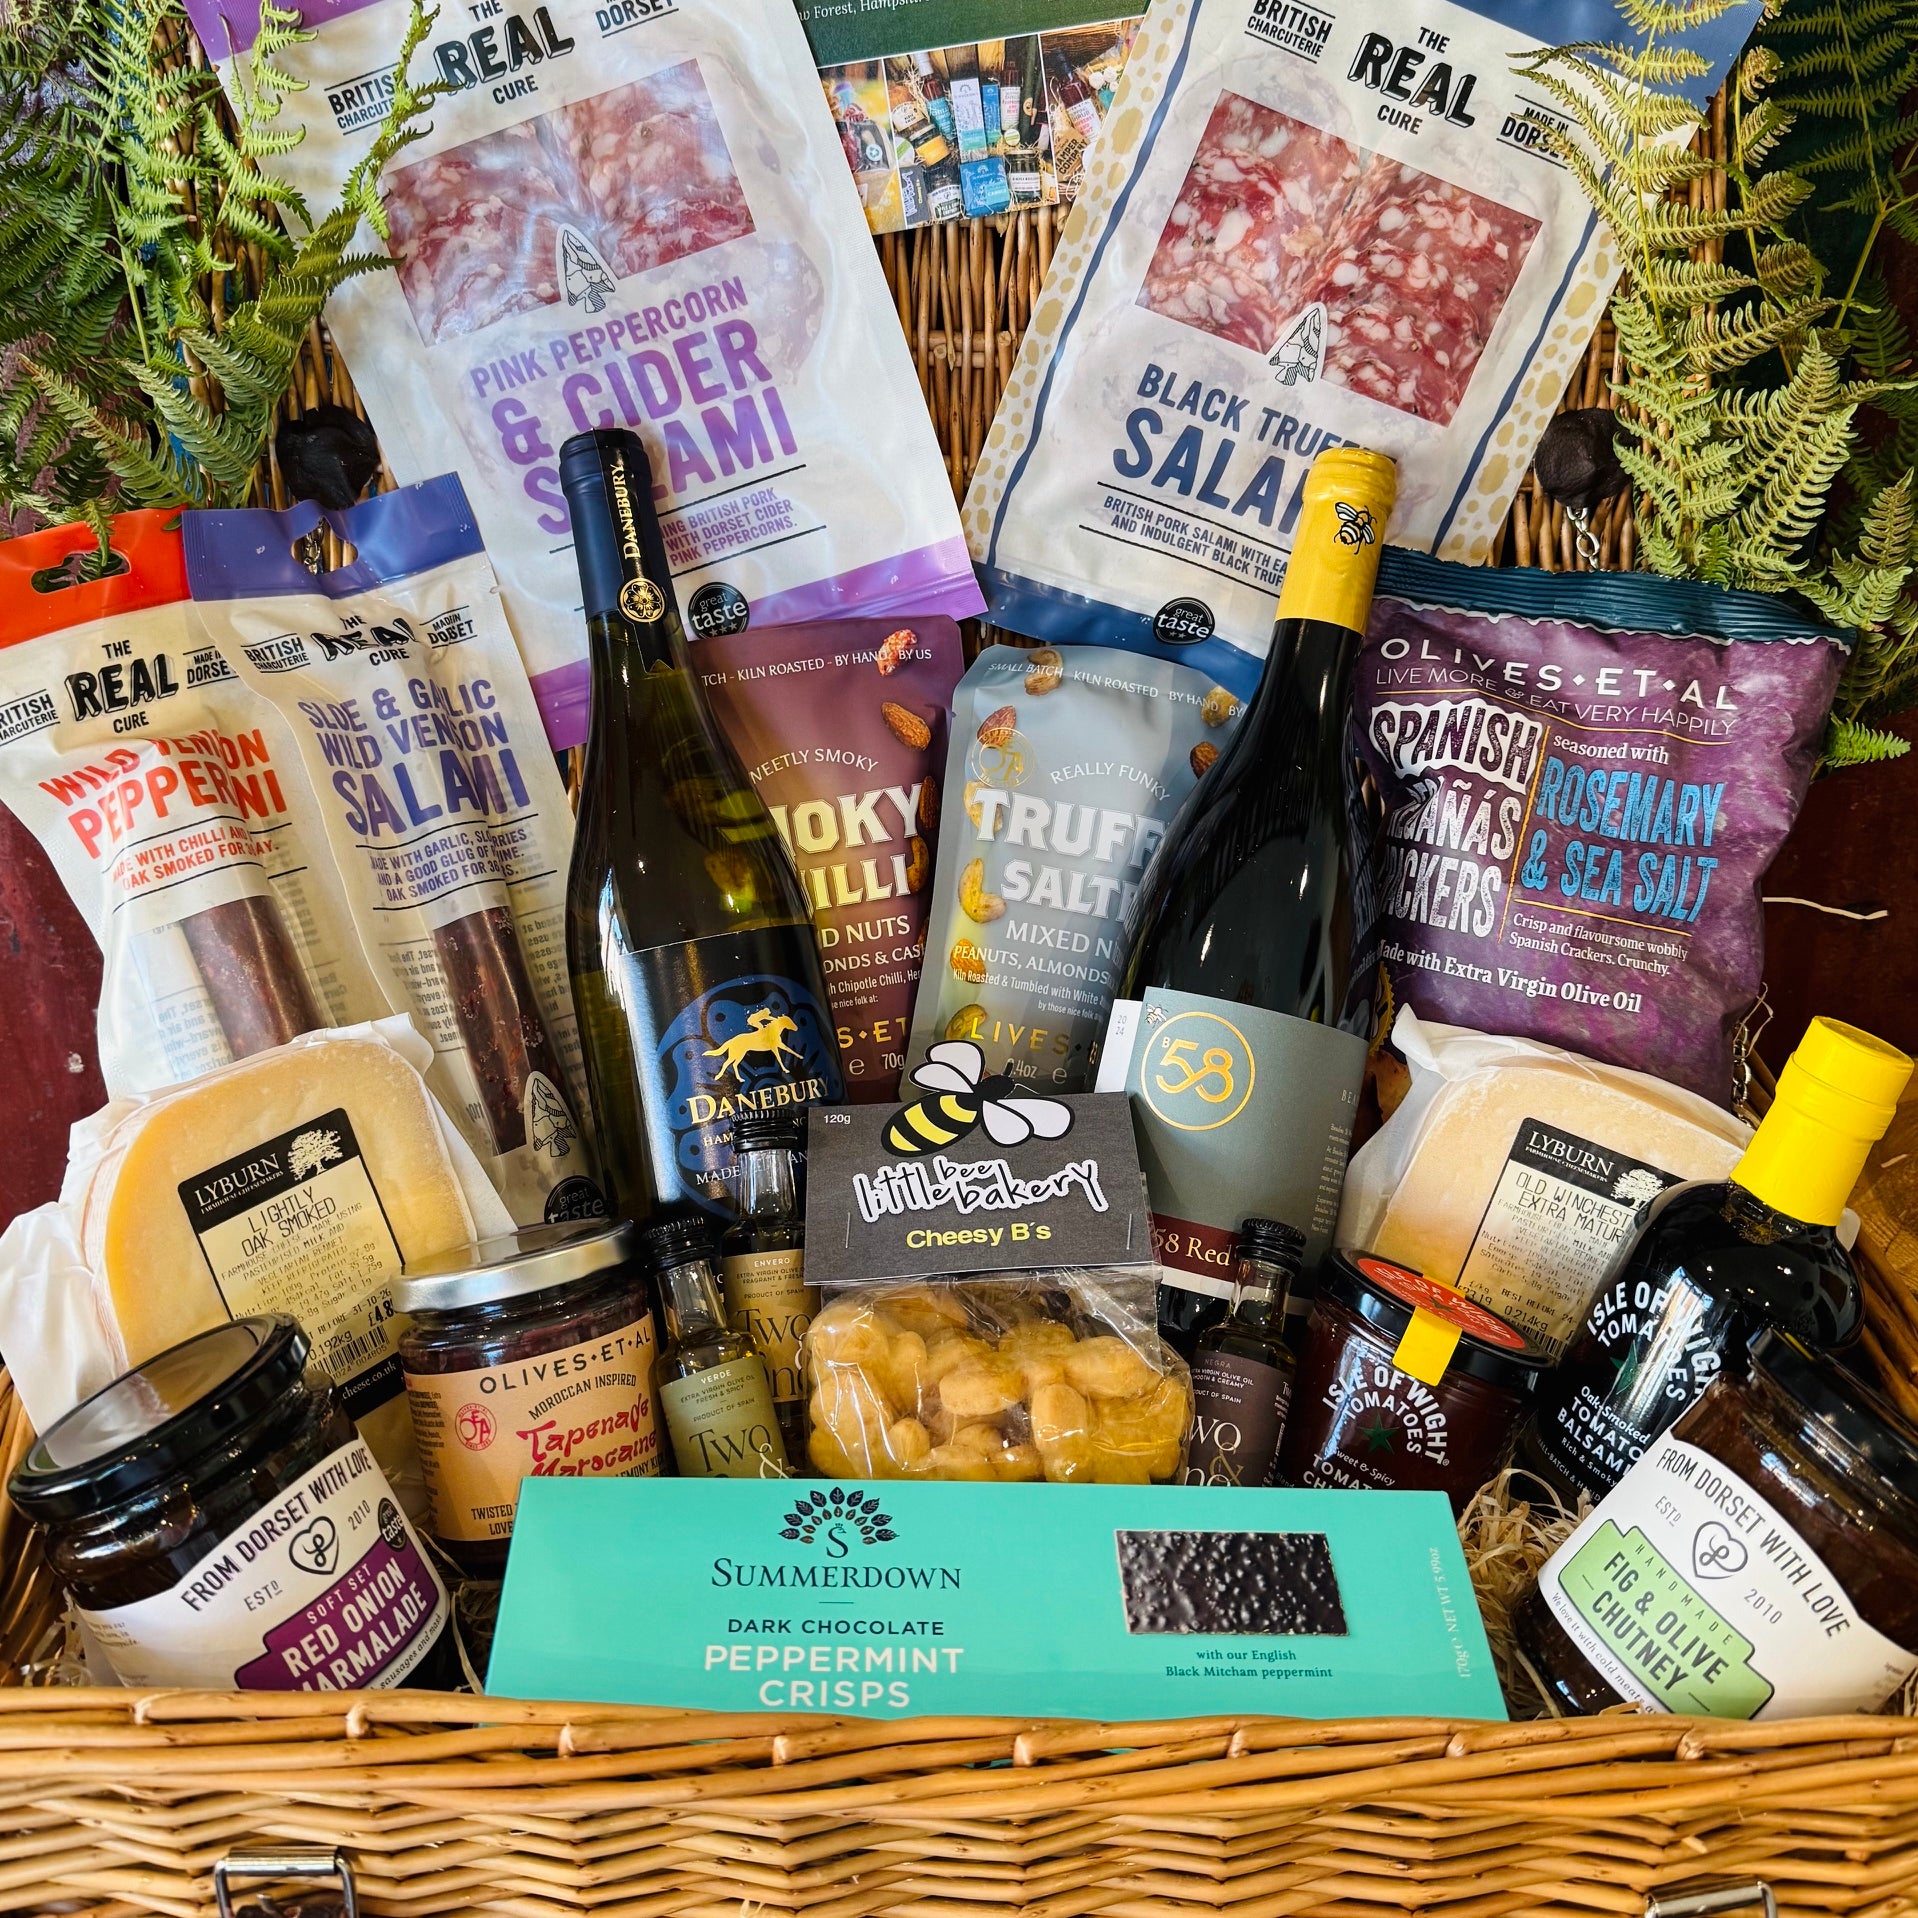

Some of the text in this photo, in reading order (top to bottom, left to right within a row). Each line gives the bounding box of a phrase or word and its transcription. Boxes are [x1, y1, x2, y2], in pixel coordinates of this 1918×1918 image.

[814, 2, 856, 20] Forest,
[1253, 0, 1332, 44] BRITISH
[432, 6, 575, 96] REAL
[1248, 16, 1324, 58] CHARCUTERIE
[1418, 26, 1450, 53] THE
[492, 75, 538, 106] CURE
[1347, 32, 1478, 128] REAL
[1377, 104, 1423, 135] CURE
[470, 276, 748, 398] PINK PEPPERCORN
[491, 318, 772, 465] & CIDER
[1137, 363, 1250, 432] BLACK
[616, 463, 641, 560] DANEBURY
[666, 499, 794, 552] WITH DORSET CIDER
[688, 487, 778, 529] BRITISH PORK
[670, 516, 798, 566] PINK PEPPERCORNS.
[1104, 496, 1154, 523] BRITISH
[1156, 512, 1190, 536] PORK
[1191, 526, 1239, 555] SALAMI
[1240, 544, 1272, 568] WITH
[1110, 514, 1137, 535] AND
[1140, 524, 1210, 559] INDULGENT
[1212, 548, 1250, 576] BLACK
[692, 598, 747, 631] taste
[1157, 612, 1210, 640] taste
[102, 640, 132, 659] THE
[244, 638, 305, 662] BRITISH
[370, 648, 410, 667] CURE
[738, 654, 849, 682] KILN ROASTED BY
[64, 653, 179, 722] REAL
[1025, 664, 1184, 702] BATCH KILN ROASTED BY
[1376, 667, 1737, 736] LIVE MORE EAT VERY HAPPILY
[113, 711, 150, 734] CURE
[298, 688, 401, 732] SLOE &
[316, 732, 383, 770] WILD
[814, 748, 879, 772] SMOKY
[1373, 703, 1540, 785] SPANISH
[1554, 732, 1670, 765] seasoned with
[38, 748, 141, 806] WILD
[332, 748, 531, 837] SALAMI
[1050, 762, 1171, 801] REALLY FUNKY
[1536, 756, 1725, 848] ROSEMARY
[136, 827, 226, 866] WITH CHILLI
[154, 848, 214, 880] SMOKED
[390, 832, 474, 870] WITH GARLIC,
[406, 848, 474, 883] GOOD GLUG
[408, 870, 460, 898] SMOKED
[1521, 828, 1718, 922] & SEA SALT
[846, 915, 911, 944] NUTS
[1006, 920, 1090, 954] MIXED
[1512, 912, 1688, 962] Crisp and flavoursome wobbly
[952, 945, 1110, 986] PEANUTS, ALMONDS
[1509, 932, 1670, 977] Spanish Crackers. Crunchy.
[838, 978, 880, 996] Chipotle
[1010, 979, 1048, 995] Tumbled
[1406, 947, 1642, 1014] with Extra Virgin Olive Oil
[686, 1078, 831, 1124] DANEBURY
[824, 1114, 850, 1126] 120g
[1528, 1130, 1616, 1176] LYBURN
[194, 1153, 281, 1208] LYBURN
[857, 1159, 1104, 1218] little bee bakery
[1516, 1172, 1547, 1194] OLD
[248, 1186, 317, 1234] LIGHTLY
[1518, 1190, 1567, 1222] EXTRA
[242, 1197, 337, 1258] OAK SMOKED
[906, 1226, 1004, 1248] Cheesy
[754, 1258, 791, 1268] ENVERO
[1186, 1237, 1232, 1266] Red
[1586, 1282, 1670, 1336] ISLE OF
[342, 1361, 397, 1400] cheese.co.uk
[528, 1373, 637, 1420] MOROCCAN INSPIRED
[700, 1370, 732, 1384] VERDE
[1217, 1378, 1244, 1388] CREAMY
[1322, 1368, 1368, 1411] ISLE
[1374, 1366, 1404, 1387] OF
[516, 1392, 648, 1463] Tapenade
[1346, 1391, 1423, 1454] TOMATOES
[1571, 1396, 1645, 1462] TOMATO
[1581, 1386, 1652, 1445] Oak-Smoked
[530, 1430, 657, 1477] Marocaine
[690, 1424, 771, 1472] Two
[1370, 1468, 1396, 1486] Spicy
[181, 1446, 372, 1612] FROM DORSET WITH LOVE
[348, 1499, 371, 1531] 2010
[471, 1504, 513, 1521] TWISTED
[1656, 1448, 1850, 1639] FROM DORSET WITH LOVE
[306, 1564, 371, 1624] SOFT SET
[712, 1558, 962, 1590] SUMMERDOWN
[1636, 1544, 1733, 1646] HANDMADE
[282, 1557, 406, 1678] RED ONION
[728, 1618, 944, 1636] DARK CHOCOLATE
[1604, 1551, 1730, 1686] FIG & OLIVE
[1744, 1588, 1784, 1625] 2010
[704, 1644, 964, 1674] PEPPERMINT
[1196, 1650, 1297, 1664] with our English
[1592, 1590, 1690, 1693] CHUTNEY
[380, 1648, 419, 1690] sausages
[1166, 1666, 1334, 1681] Black Mitcham peppermint
[759, 1680, 910, 1708] CRISPS
